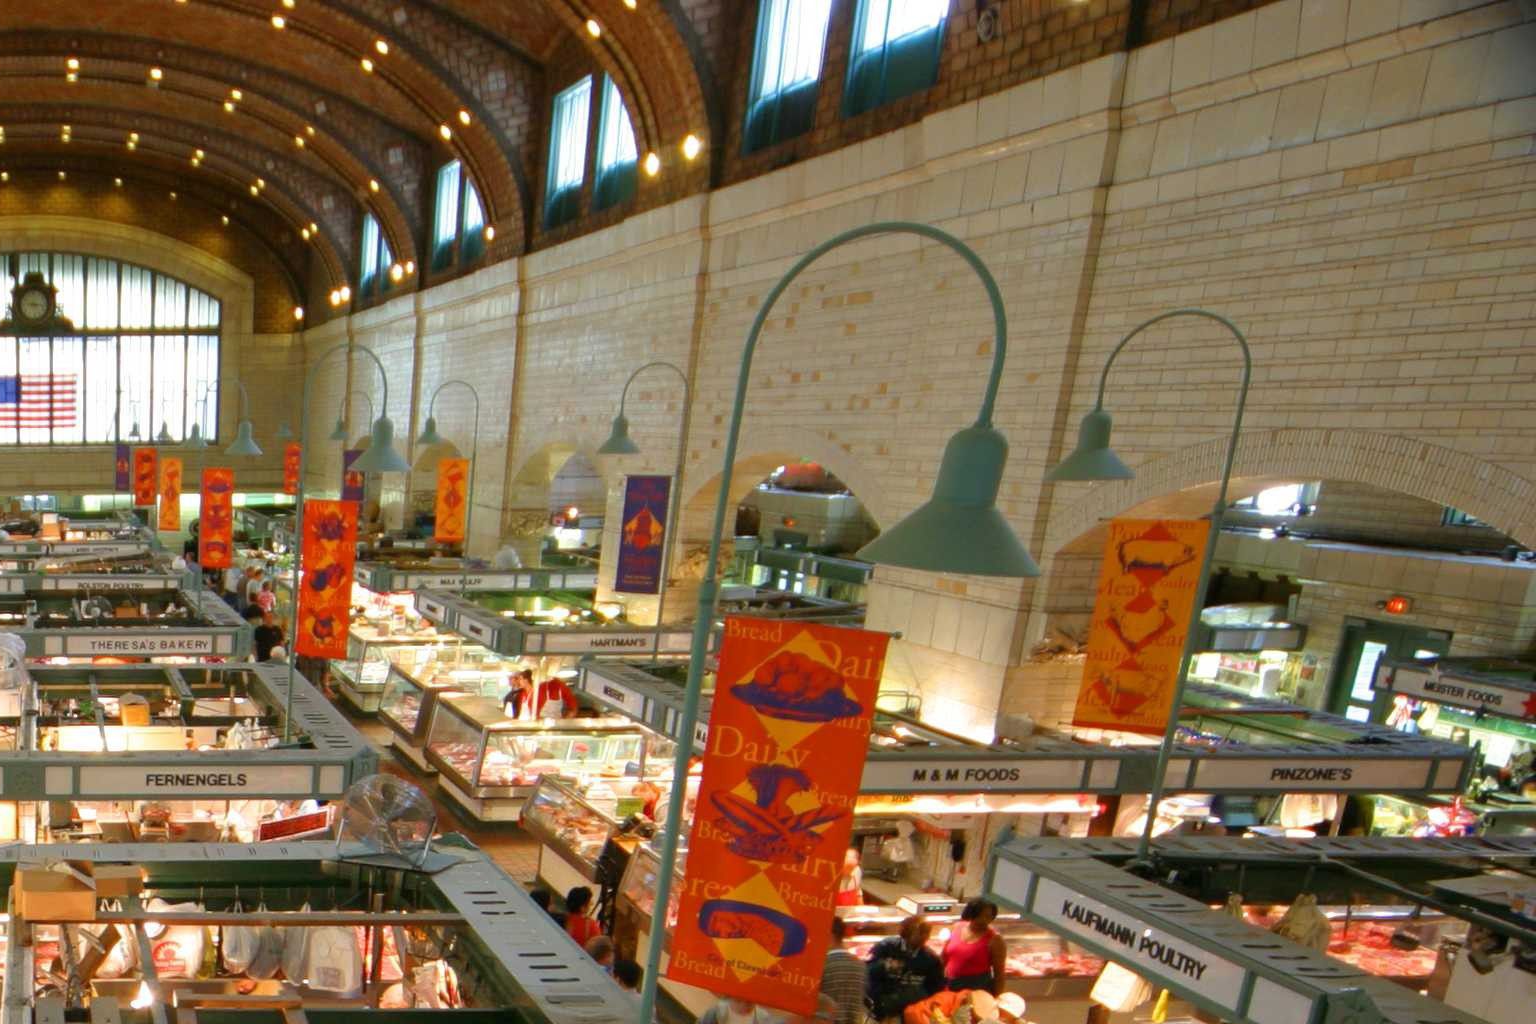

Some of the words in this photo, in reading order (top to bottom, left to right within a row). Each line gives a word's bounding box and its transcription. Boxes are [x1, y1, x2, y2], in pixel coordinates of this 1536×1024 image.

[727, 619, 783, 643] Bread
[91, 640, 156, 650] THERESA'S
[160, 639, 209, 650] BAKERY
[591, 637, 646, 647] HARTMAN'S
[1467, 688, 1503, 705] FOODS
[145, 774, 247, 787] FERNENGELS
[912, 768, 927, 781] M
[930, 768, 942, 781] &
[945, 768, 960, 781] M
[964, 768, 1020, 781] FOODS
[1271, 767, 1352, 781] PINZONE'S
[778, 881, 834, 910] Bread
[1061, 899, 1137, 948] KAUFMANN
[1138, 936, 1207, 981] POULTRY
[674, 950, 727, 979] Bread
